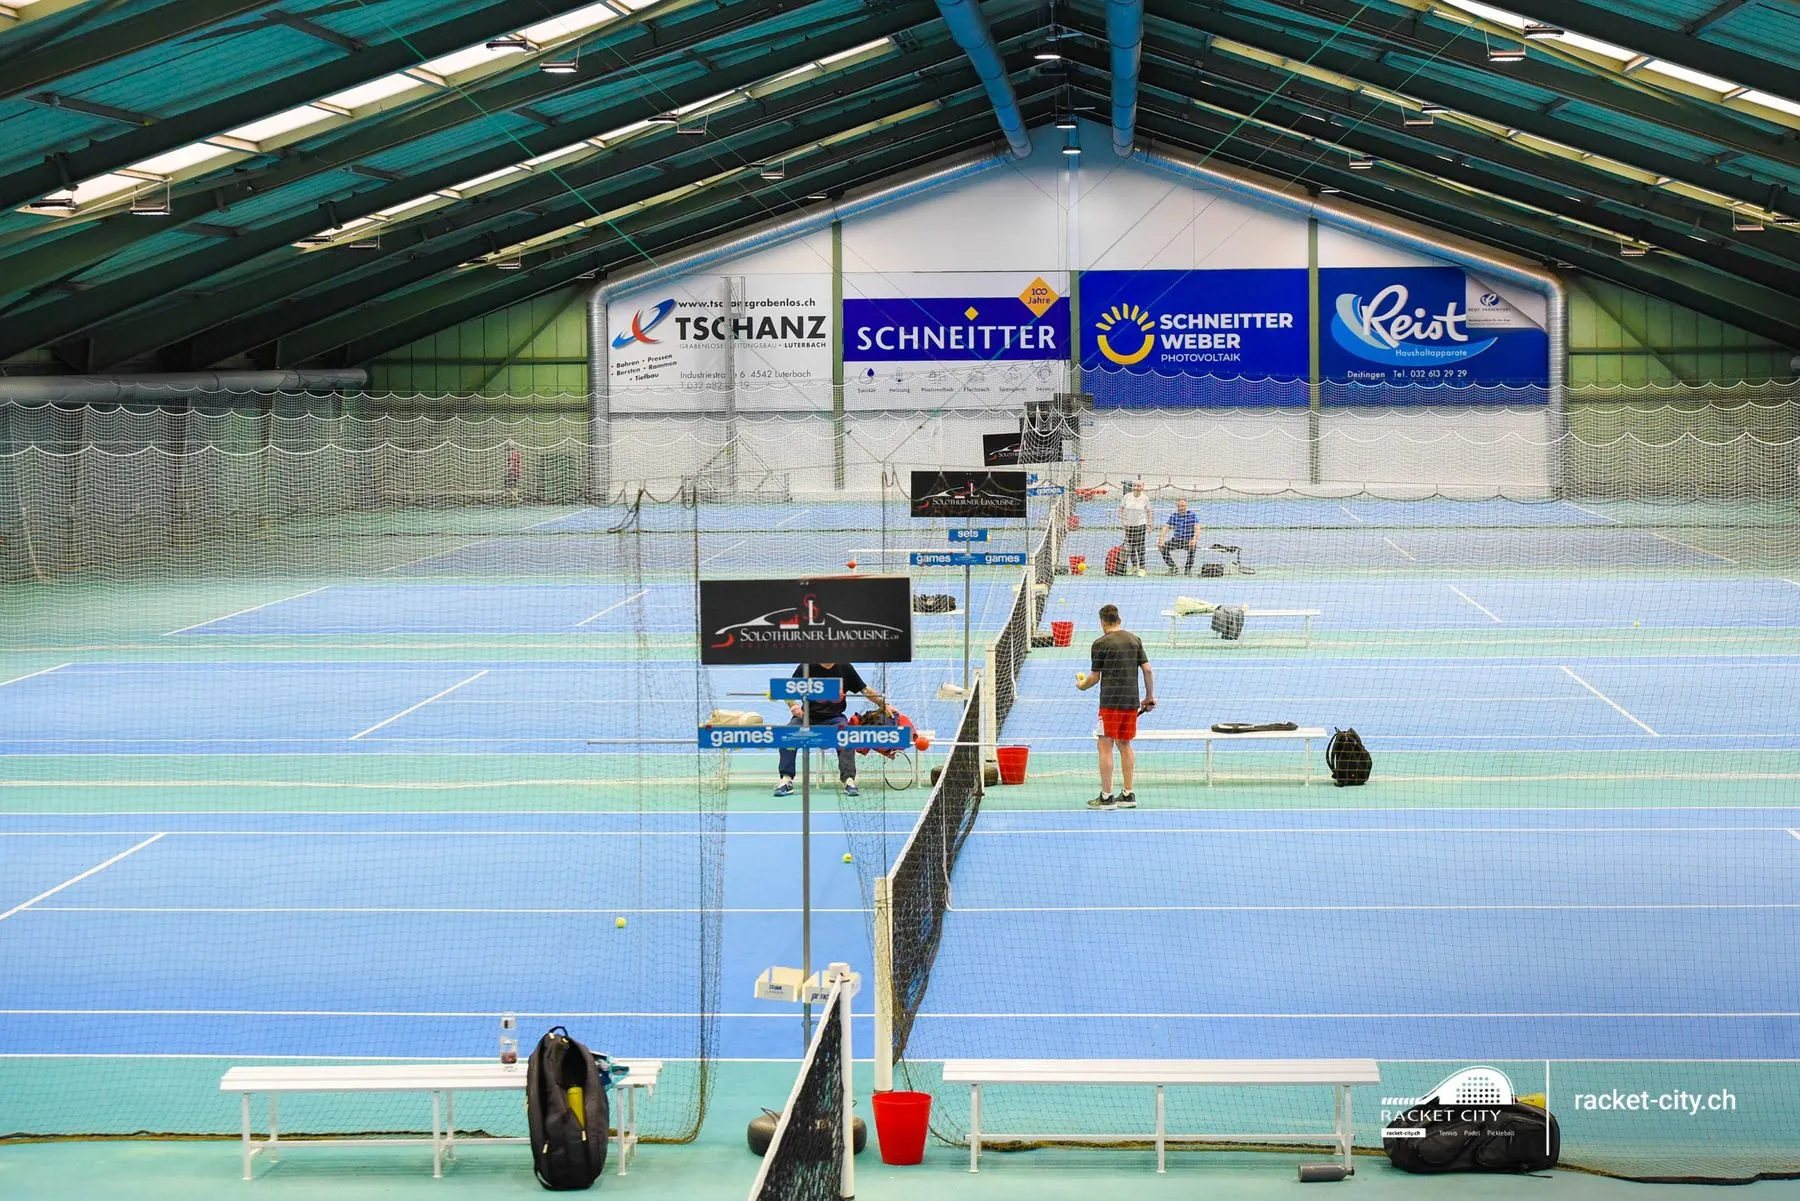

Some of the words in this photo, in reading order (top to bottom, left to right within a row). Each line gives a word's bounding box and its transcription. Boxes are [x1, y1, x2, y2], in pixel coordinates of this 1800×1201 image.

[1031, 287, 1048, 296] 100
[1026, 296, 1051, 305] Jahre
[1160, 313, 1293, 329] SCHNEITTER
[1361, 284, 1469, 349] Reist
[675, 315, 827, 341] TSCHANZ
[857, 325, 1057, 351] SCHNEITTER
[1160, 334, 1241, 349] WEBER
[784, 341, 826, 349] LUTERBACH
[1161, 353, 1241, 362] PHOTOVOLTAIK
[1395, 349, 1468, 358] Haushaltapparate
[616, 360, 640, 369] Bohren
[647, 353, 673, 363] Pressen
[616, 367, 641, 377] Bersten
[648, 360, 678, 371] Rammen
[739, 370, 746, 379] 6
[750, 369, 772, 378] 4542
[774, 369, 812, 378] Luterbach
[1347, 370, 1386, 379] Deitingen
[1393, 369, 1408, 378] Tel.
[1410, 369, 1426, 378] 032
[1428, 369, 1441, 378] 613
[1444, 369, 1454, 379] 29
[1457, 369, 1468, 378] 29
[635, 372, 659, 382] Tiefbau
[957, 528, 979, 538] sets
[916, 554, 951, 565] games
[985, 554, 1020, 565] games
[785, 678, 824, 694] sets
[710, 730, 774, 748] games
[836, 730, 900, 748] games
